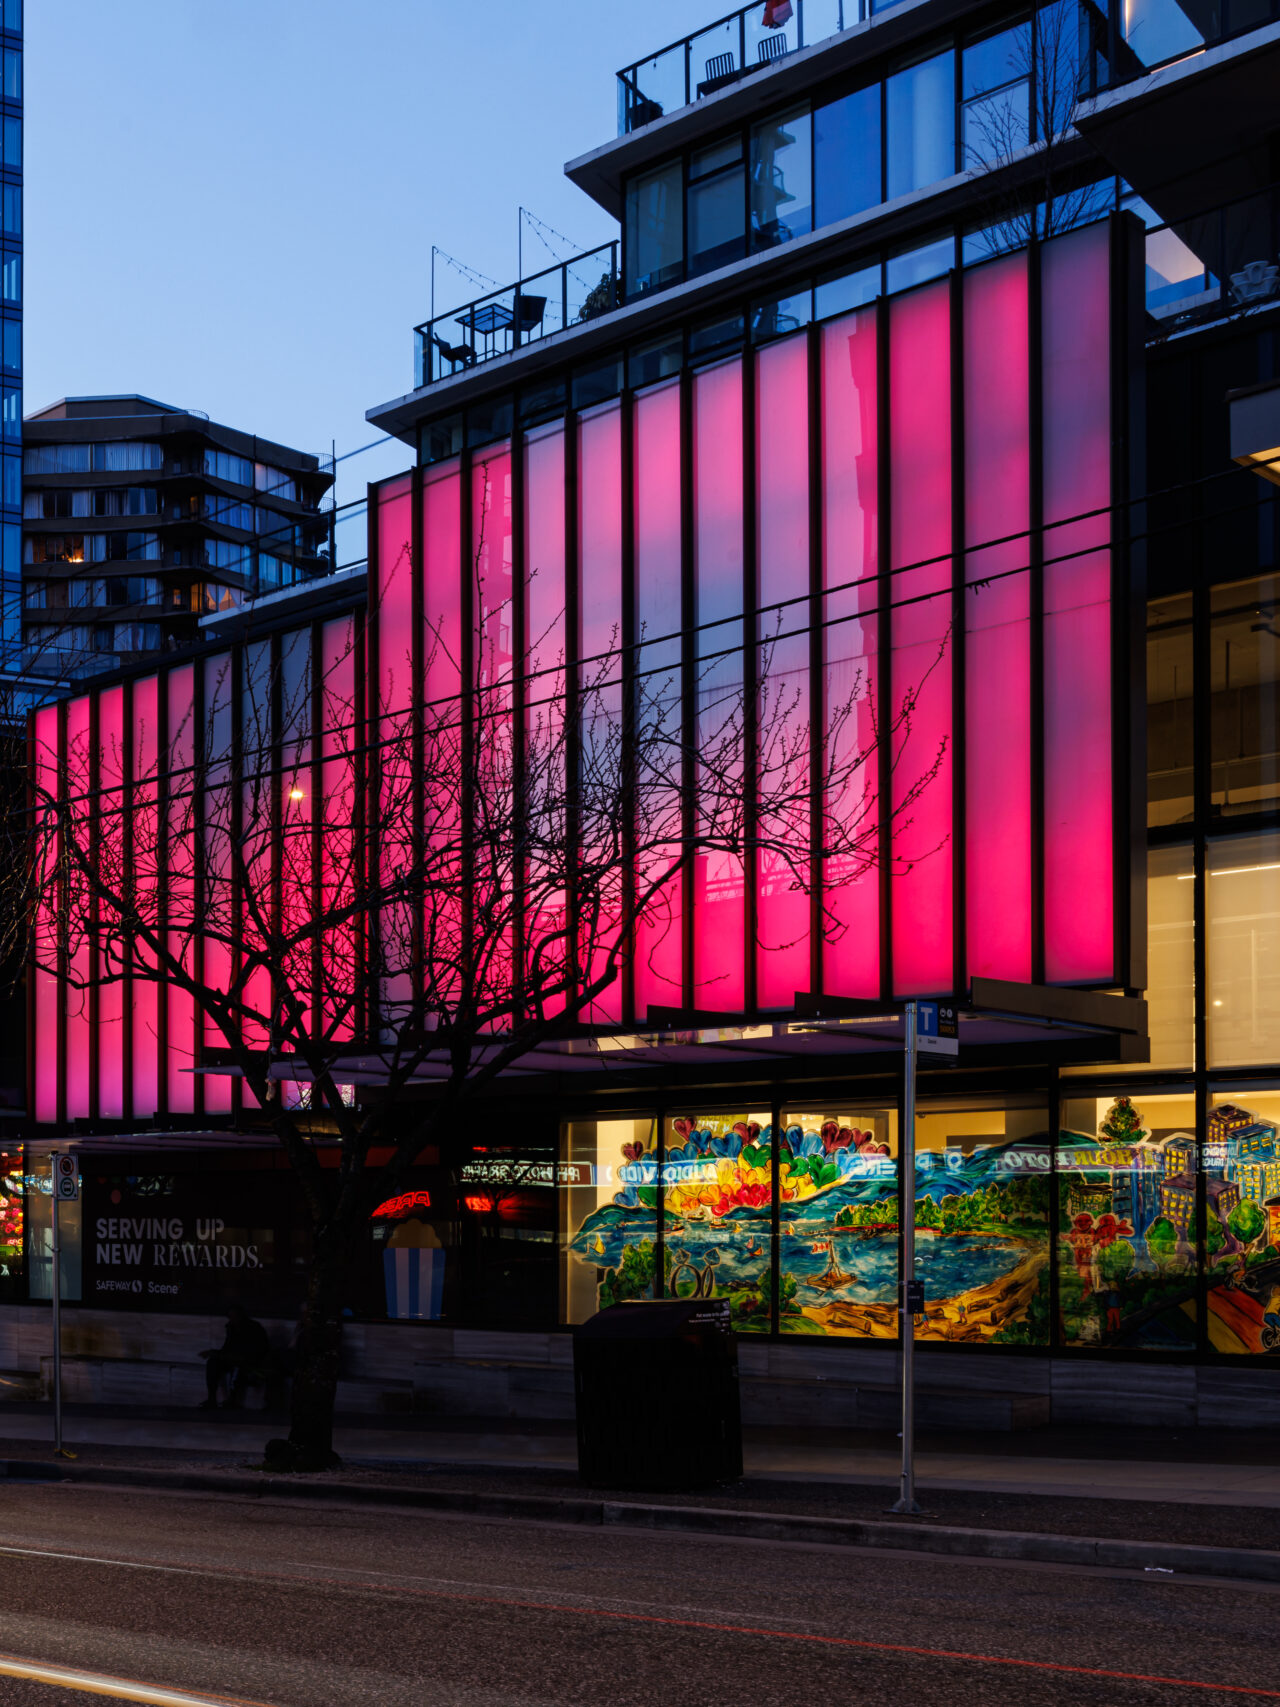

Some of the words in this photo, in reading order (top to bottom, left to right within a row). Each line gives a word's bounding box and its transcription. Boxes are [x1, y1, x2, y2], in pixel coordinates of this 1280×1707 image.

[920, 1007, 933, 1031] T
[96, 1217, 184, 1240] SERVING
[195, 1218, 225, 1240] UP
[96, 1243, 144, 1265] NEW
[153, 1243, 264, 1269] REWARDS.
[96, 1280, 131, 1291] SAFEWAY
